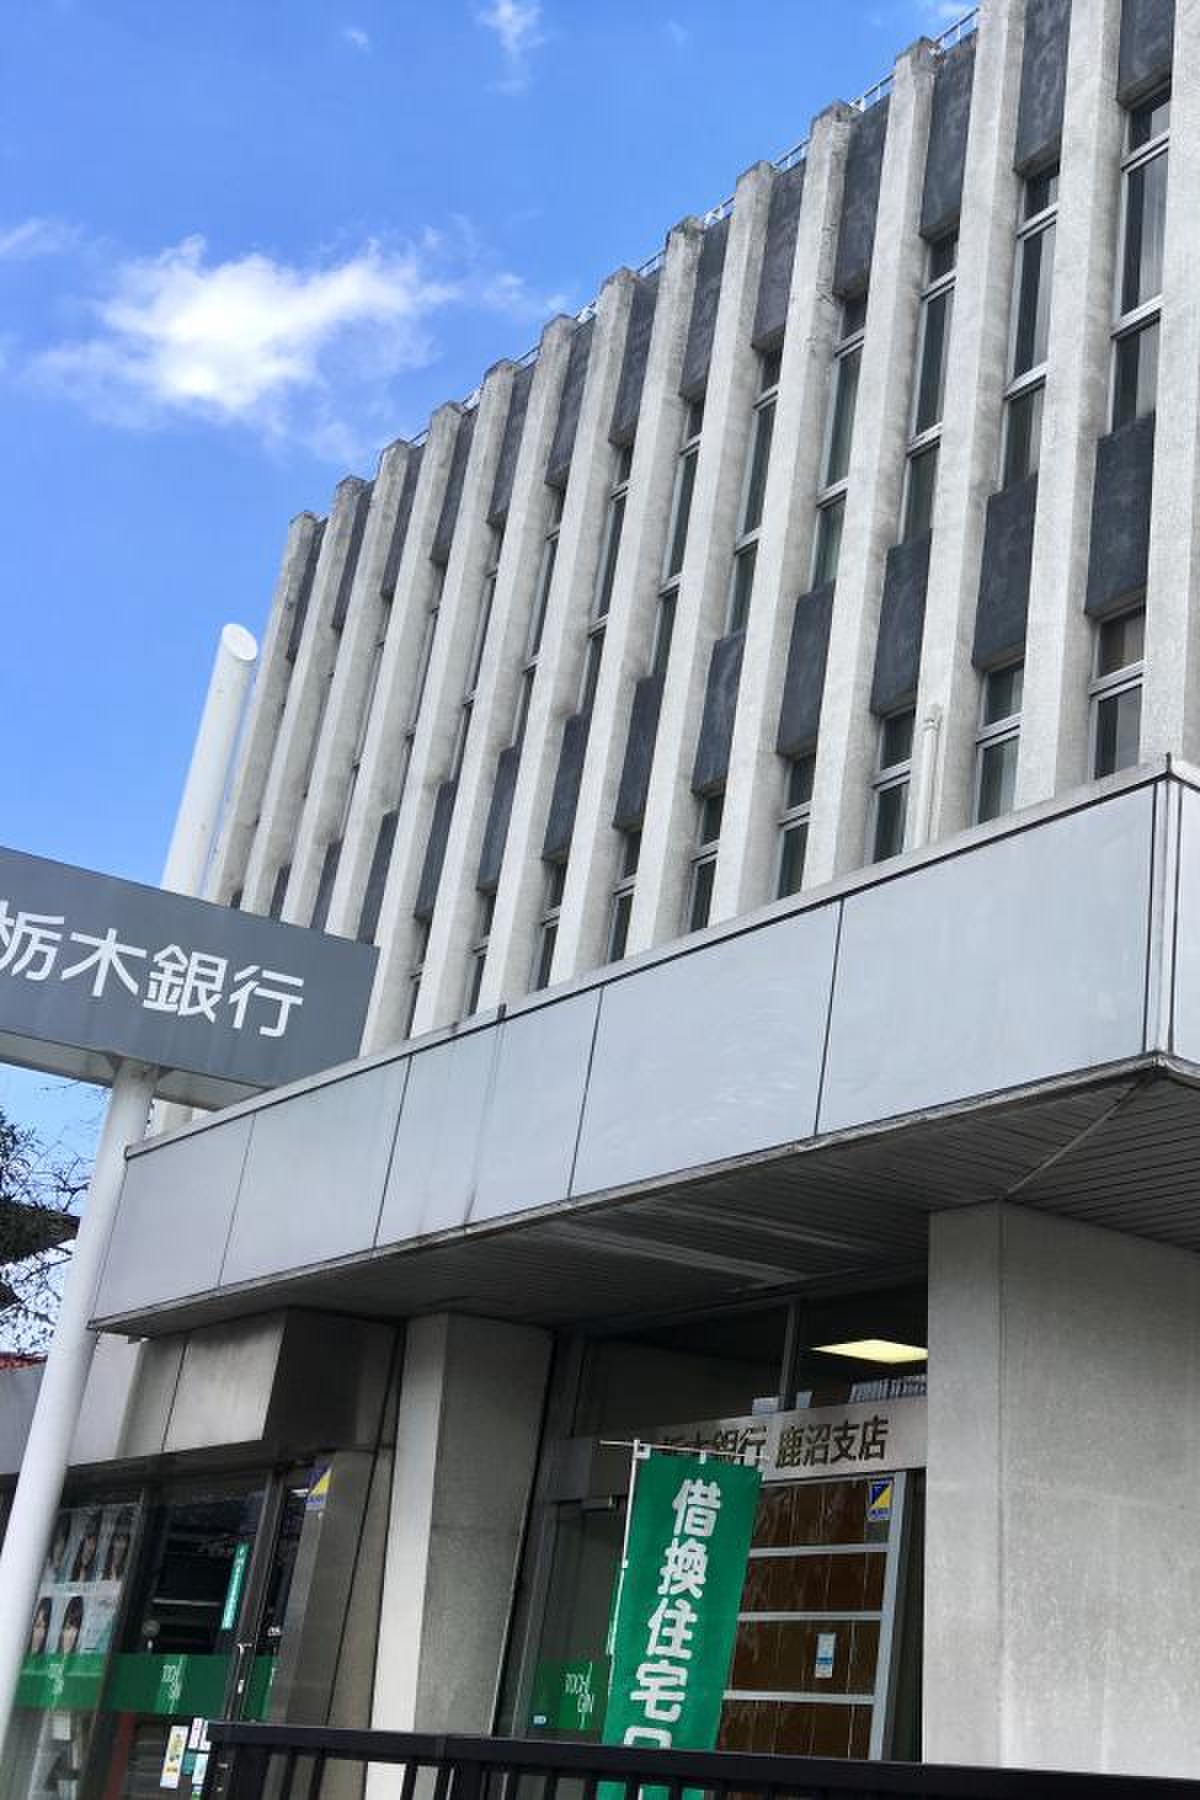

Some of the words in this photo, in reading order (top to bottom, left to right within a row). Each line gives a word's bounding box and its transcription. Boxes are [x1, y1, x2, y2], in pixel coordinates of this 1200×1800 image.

[0, 899, 304, 1037] 栃木銀行
[775, 1414, 889, 1469] 鹿沼支店
